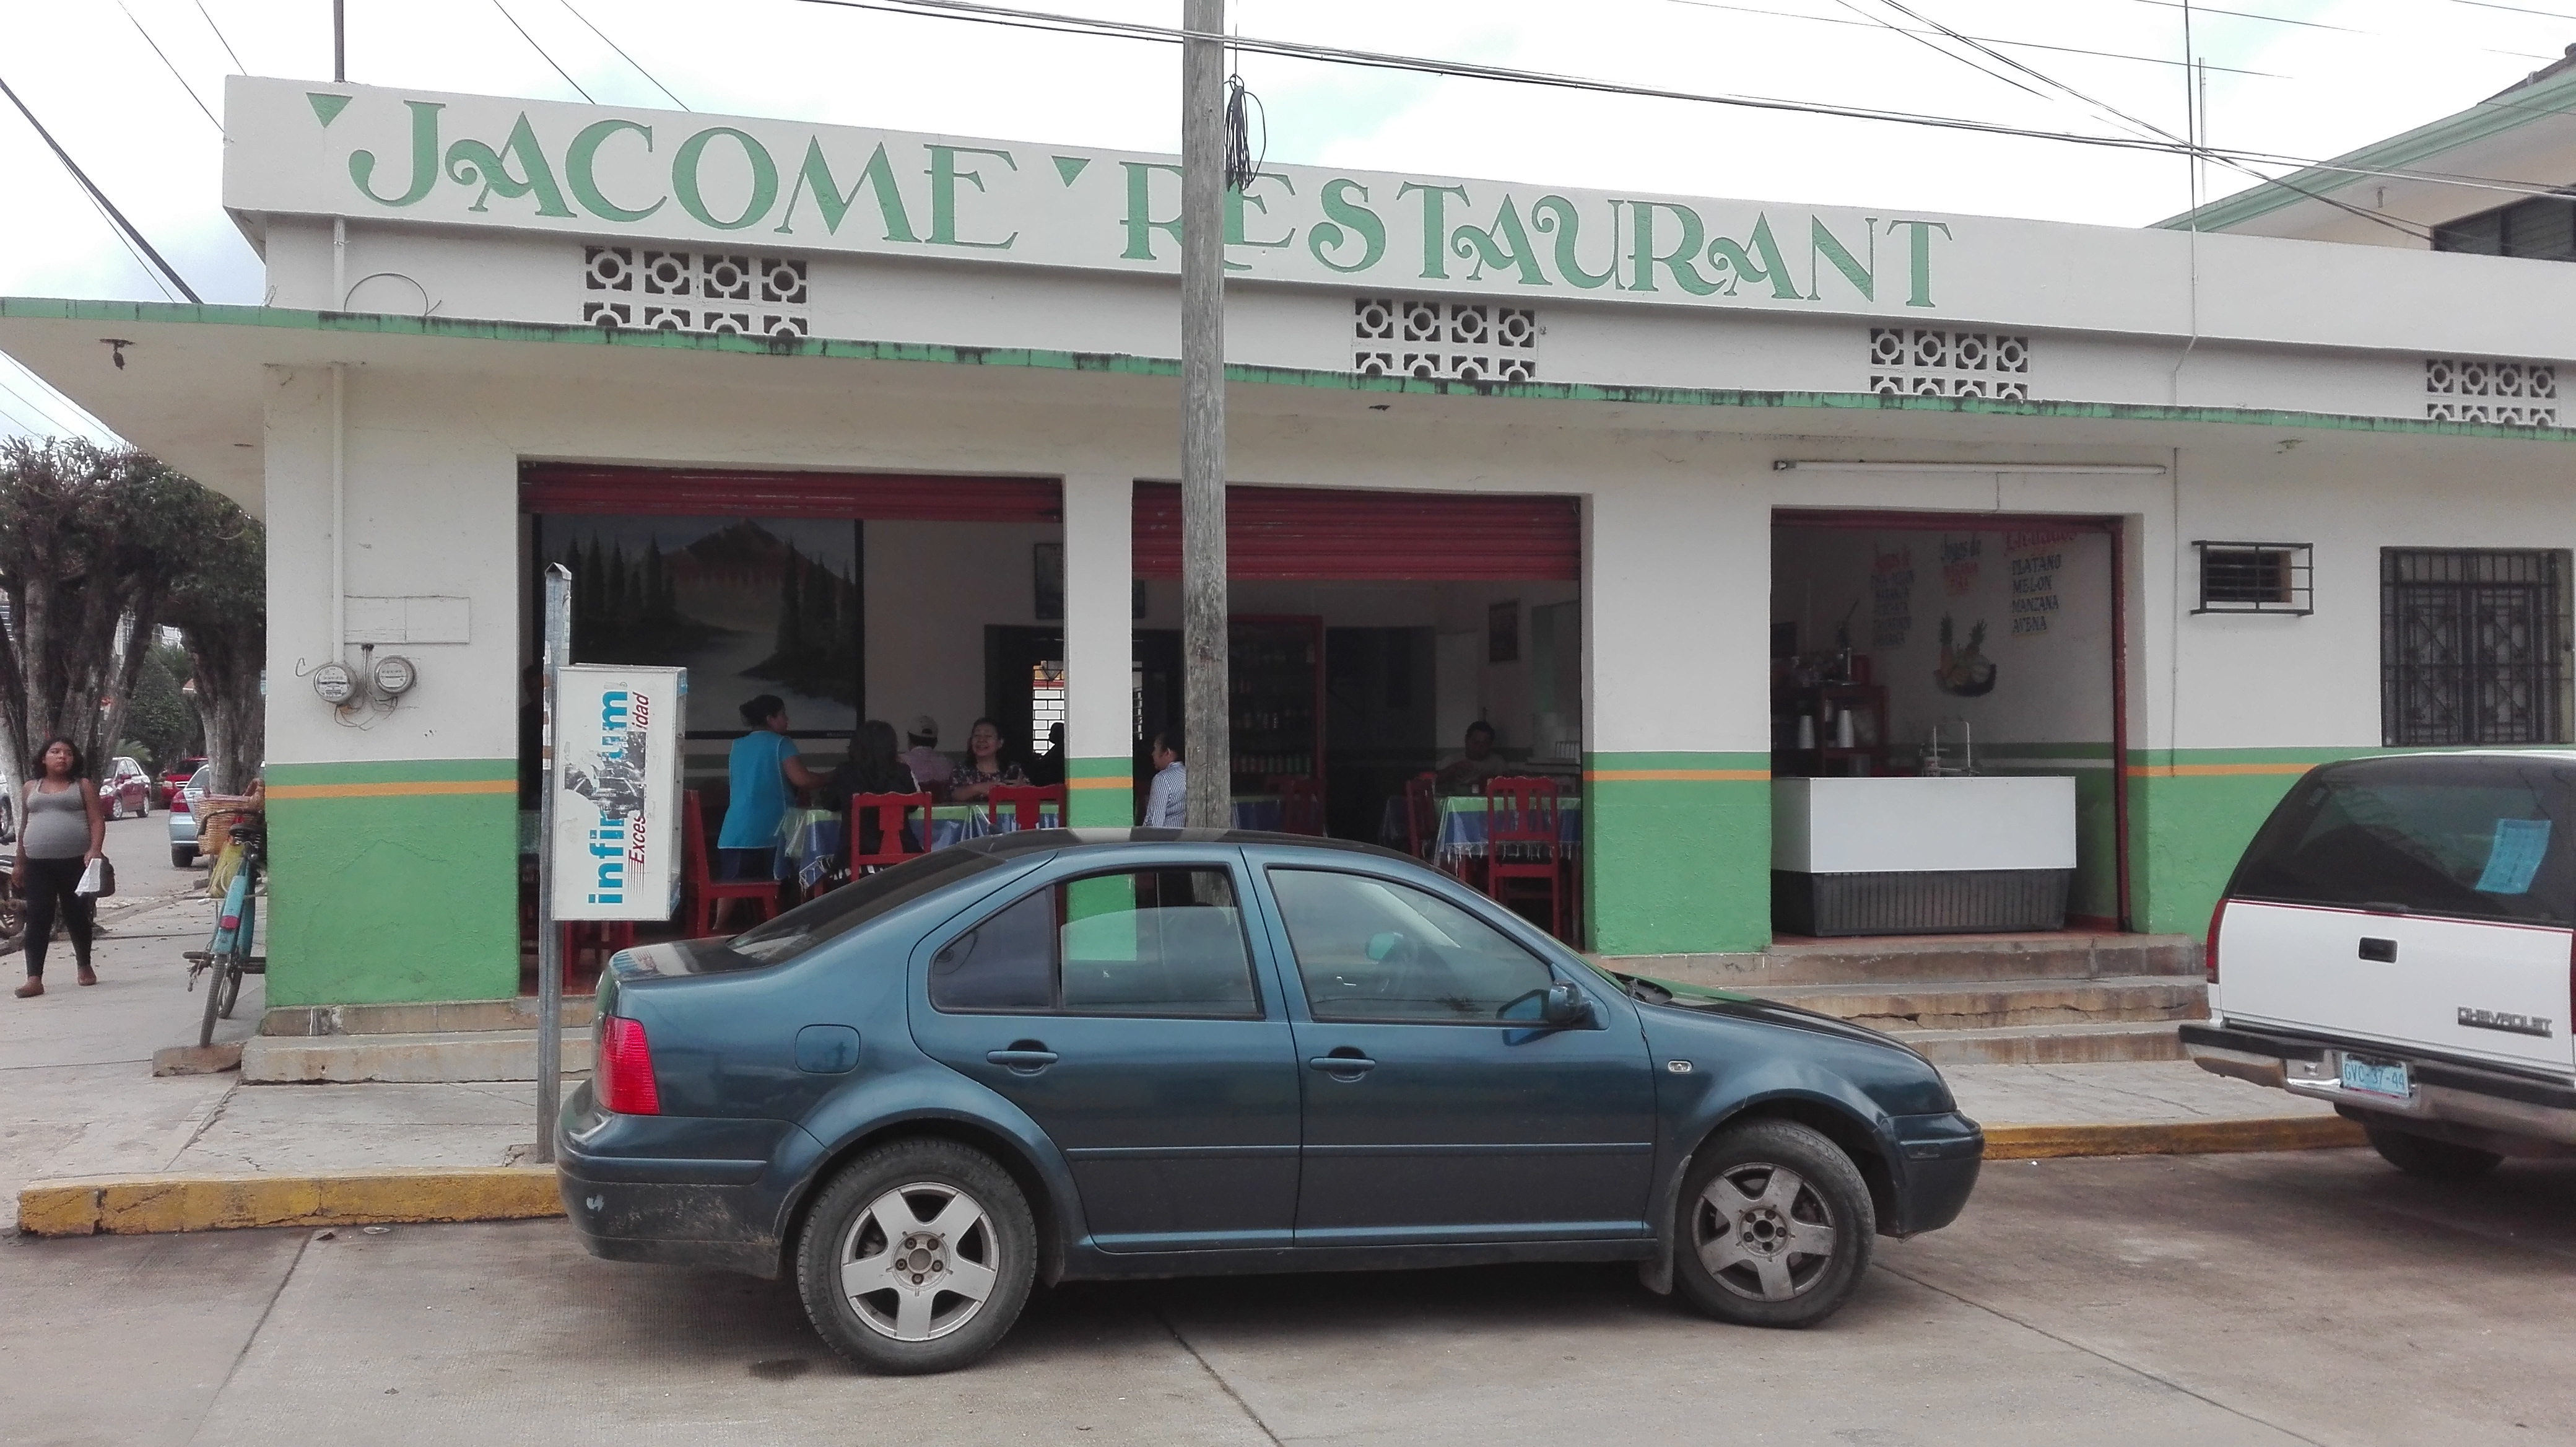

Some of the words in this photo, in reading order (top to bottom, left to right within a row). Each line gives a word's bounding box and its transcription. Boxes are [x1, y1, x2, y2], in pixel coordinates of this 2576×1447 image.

[348, 98, 1019, 250] JACOME
[1118, 160, 1952, 308] RESTAURANT
[2012, 554, 2061, 575] PLATANO
[2012, 575, 2052, 593] MELON
[2011, 595, 2060, 613] MANZANA
[2012, 616, 2047, 633] AVENA
[2457, 1006, 2553, 1036] CHEVROLET
